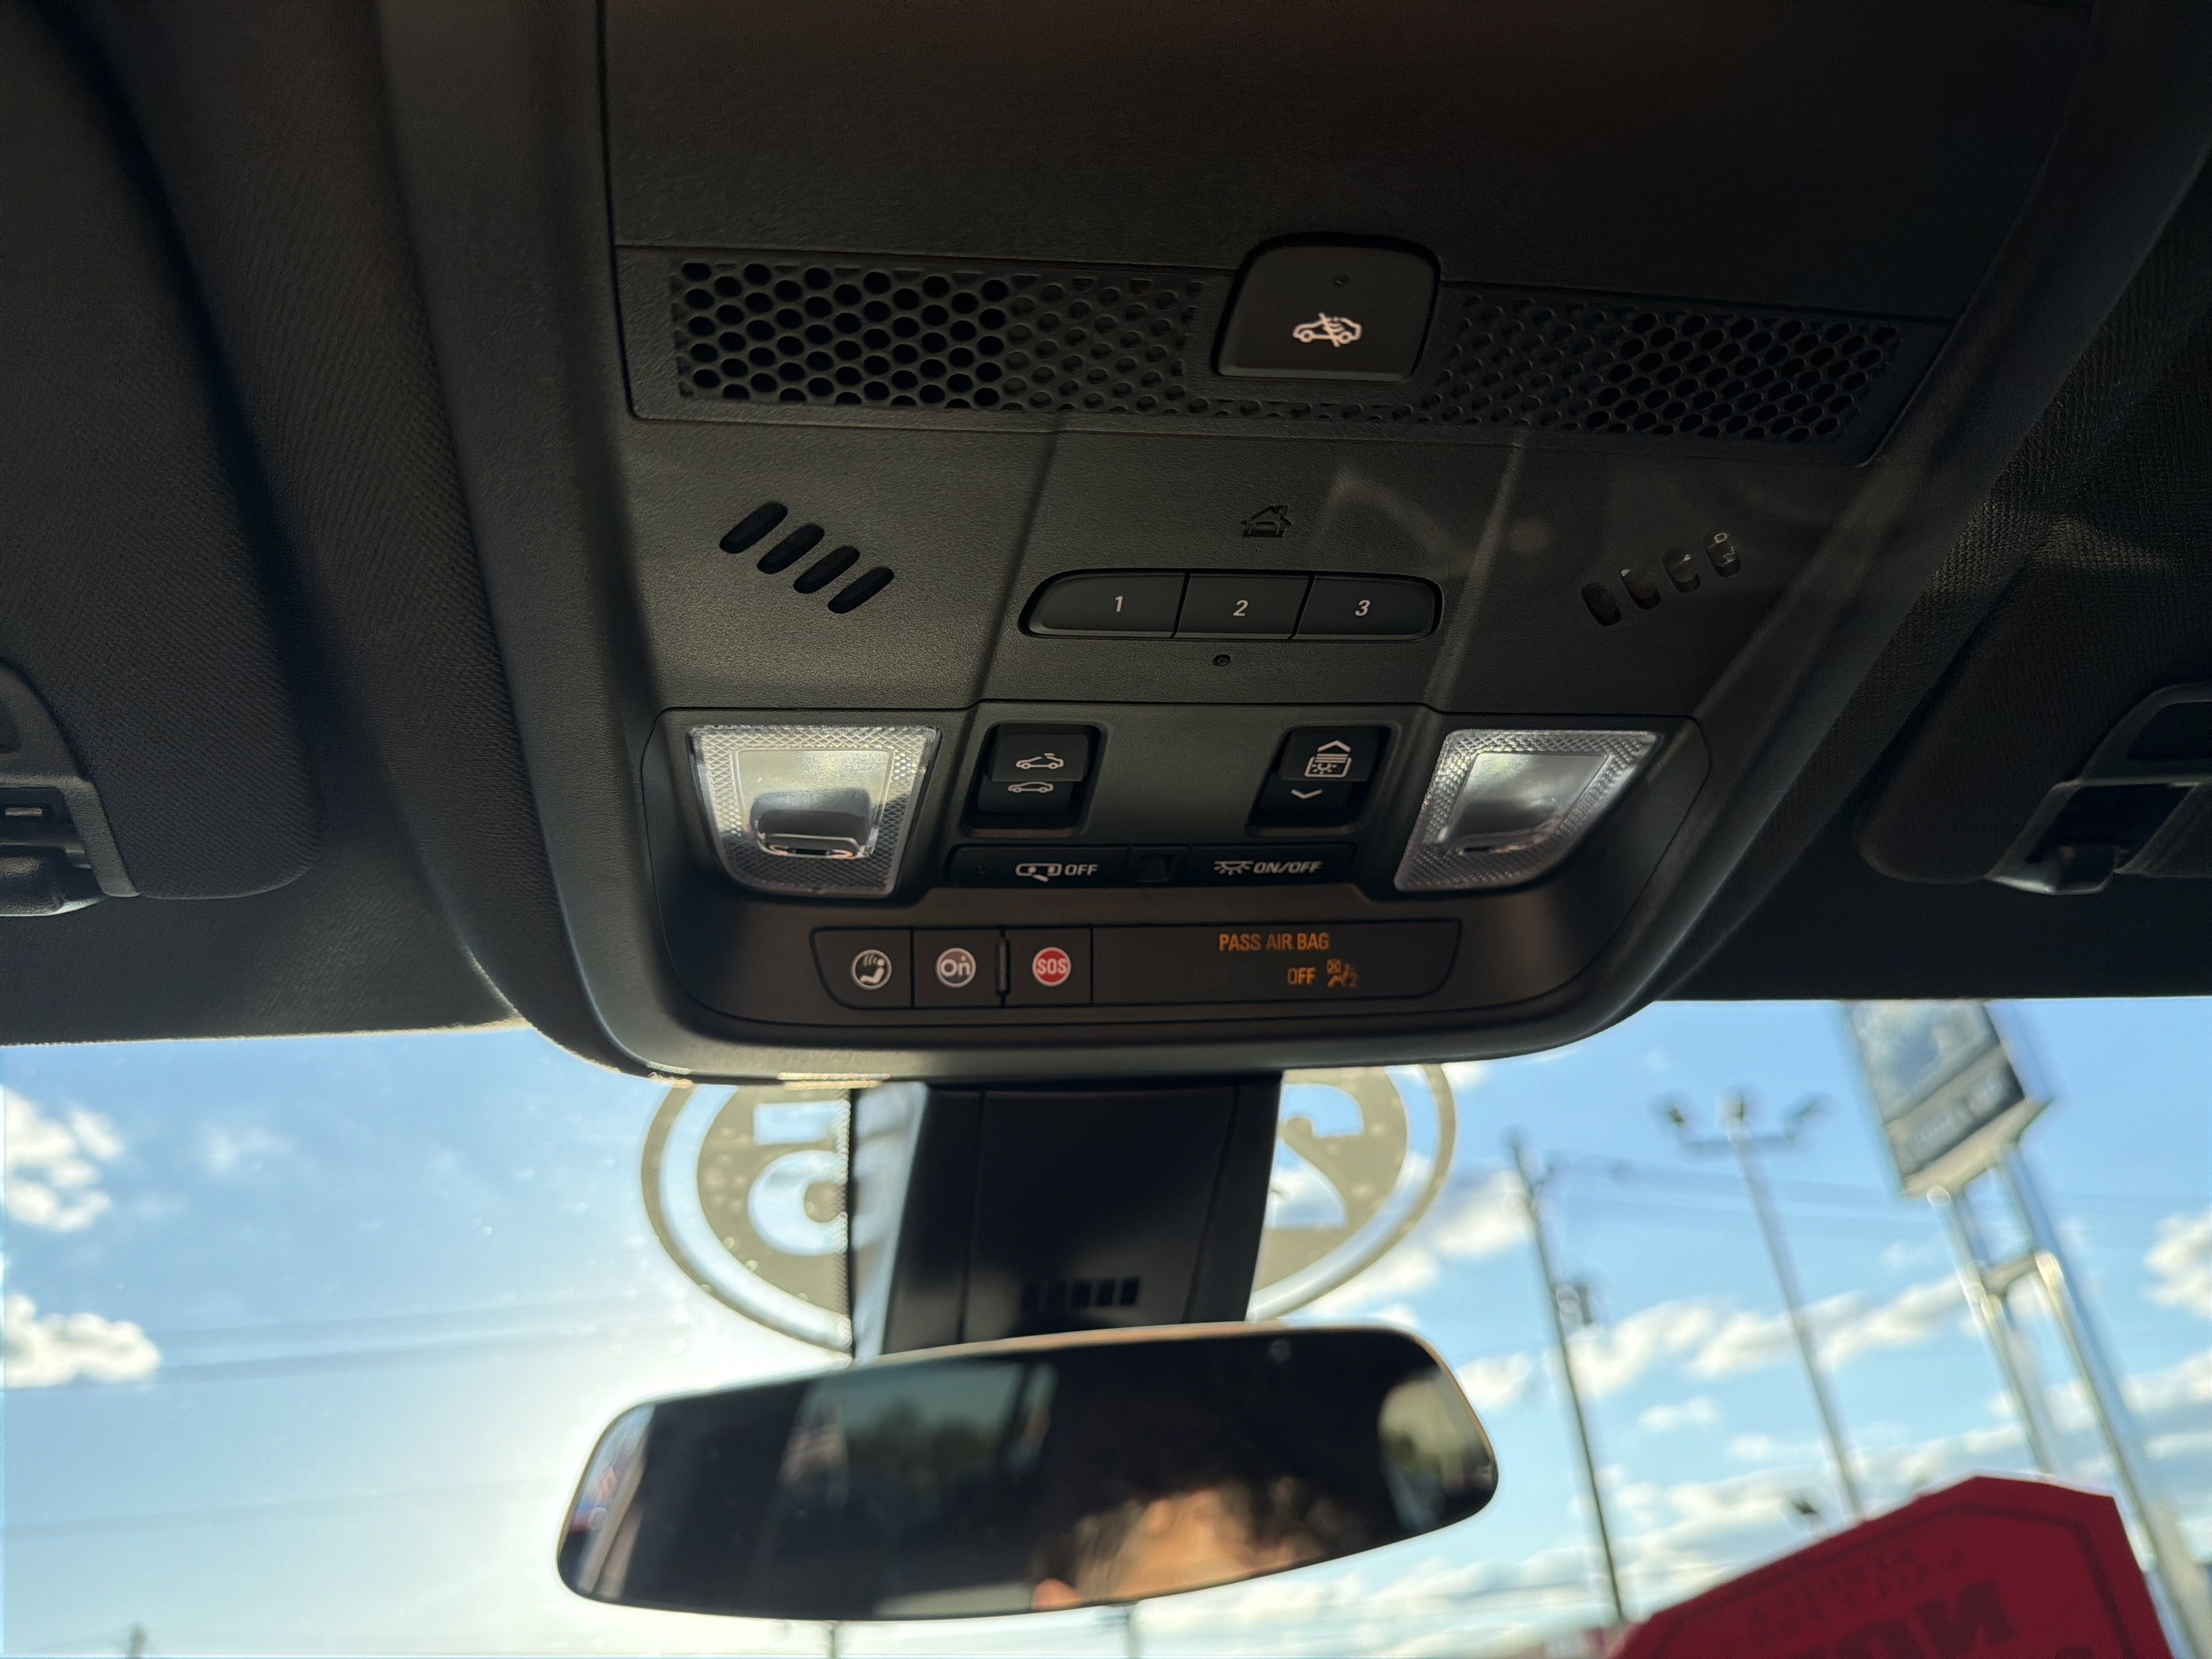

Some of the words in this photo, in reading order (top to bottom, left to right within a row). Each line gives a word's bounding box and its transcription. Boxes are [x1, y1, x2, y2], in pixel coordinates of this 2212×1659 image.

[1115, 596, 1124, 612] 1
[1233, 600, 1249, 617] 2
[1355, 600, 1370, 616] 3
[1064, 864, 1098, 876] OFF
[1253, 861, 1322, 874] ON/OFF
[1219, 933, 1261, 951] PASS
[1266, 933, 1294, 950] AIR
[1297, 933, 1330, 951] BAG
[940, 956, 970, 977] On
[1037, 957, 1068, 975] SOS
[1288, 967, 1316, 985] OFF
